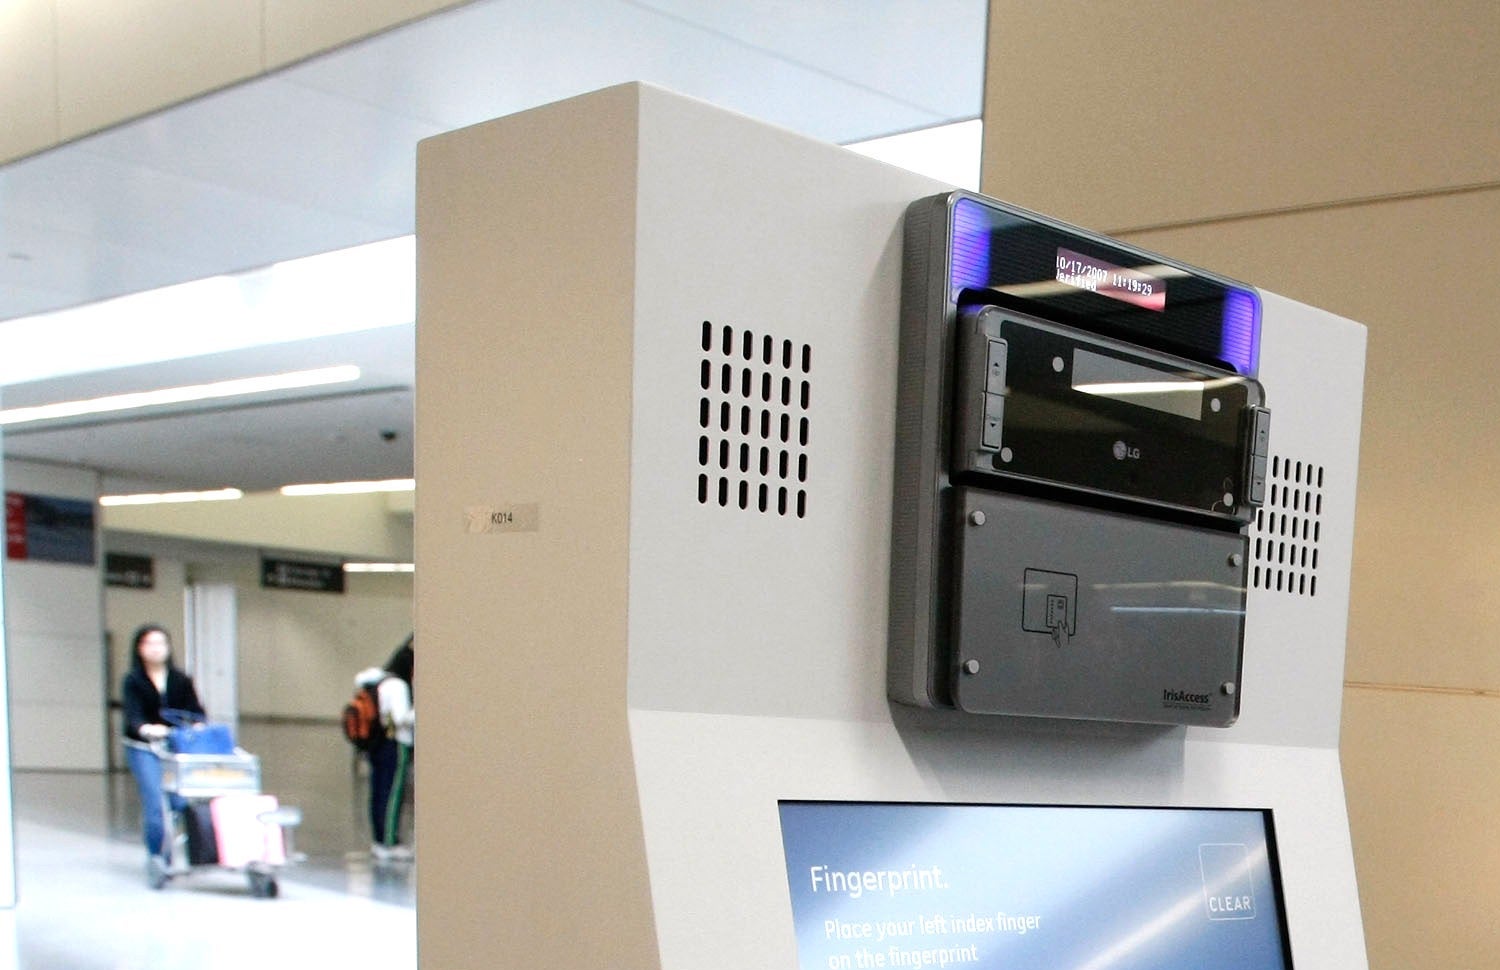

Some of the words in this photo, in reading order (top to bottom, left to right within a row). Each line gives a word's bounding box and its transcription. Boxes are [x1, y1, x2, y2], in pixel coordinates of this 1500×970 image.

[1056, 255, 1108, 282] 10/17/2007
[1113, 274, 1153, 297] 11:19:29
[1127, 446, 1140, 460] LG
[491, 511, 513, 525] K014
[1163, 689, 1209, 704] IrisAccess
[809, 863, 949, 899] Fingerprint.
[1209, 895, 1252, 913] CLEAR
[824, 918, 872, 940] Place
[876, 919, 915, 942] your
[918, 914, 948, 936] left
[950, 911, 994, 934] index
[996, 911, 1041, 935] finger
[828, 954, 850, 970] on
[854, 949, 886, 970] the
[888, 943, 979, 970] fingerprint
